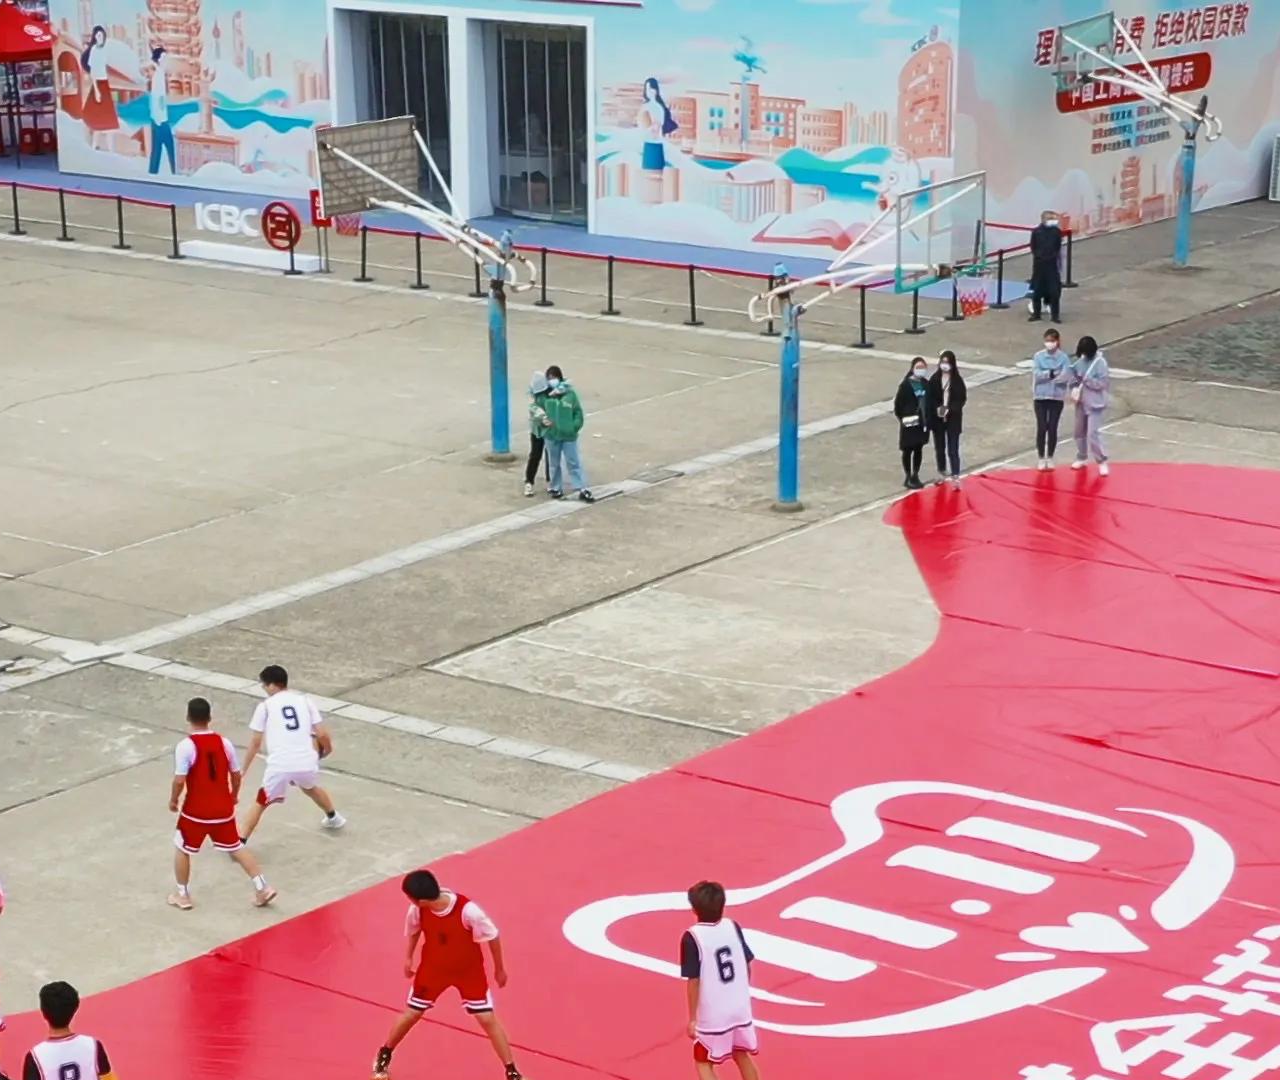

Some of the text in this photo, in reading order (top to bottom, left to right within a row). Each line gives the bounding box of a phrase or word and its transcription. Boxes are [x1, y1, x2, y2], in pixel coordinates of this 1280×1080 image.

[1152, 2, 1250, 49] 拒绝校园贷款
[194, 202, 260, 238] ICBC
[281, 705, 300, 731] 9
[715, 945, 735, 984] 6
